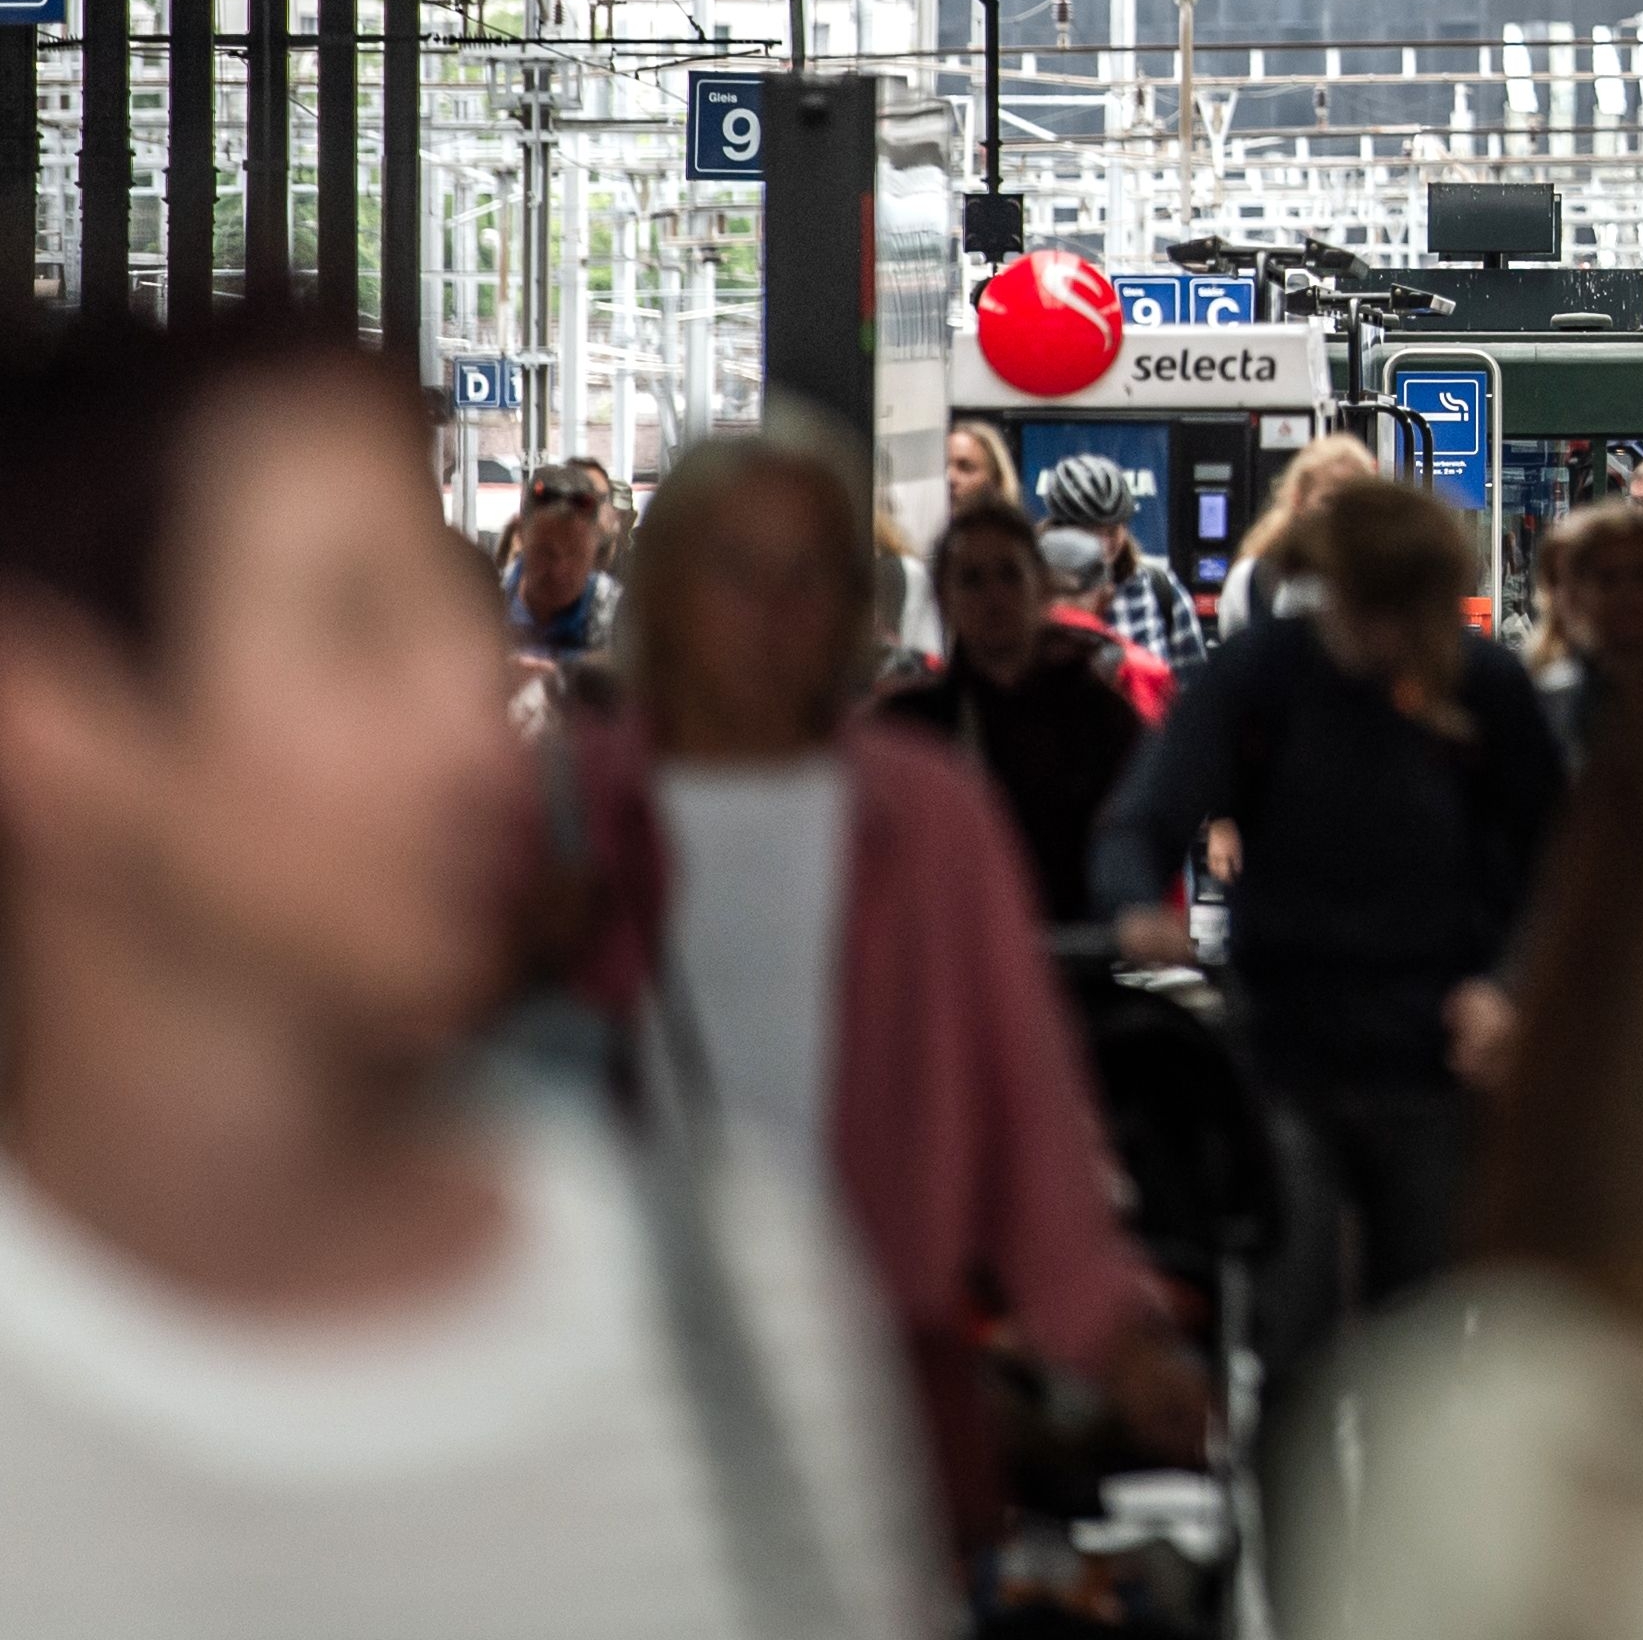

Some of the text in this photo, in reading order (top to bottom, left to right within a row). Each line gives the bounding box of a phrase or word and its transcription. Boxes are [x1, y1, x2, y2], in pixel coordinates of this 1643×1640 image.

[708, 92, 738, 104] Gleis
[722, 108, 762, 162] 9
[1132, 297, 1162, 329] 9
[1206, 297, 1241, 328] C
[1132, 348, 1277, 382] selecta
[467, 372, 490, 402] D
